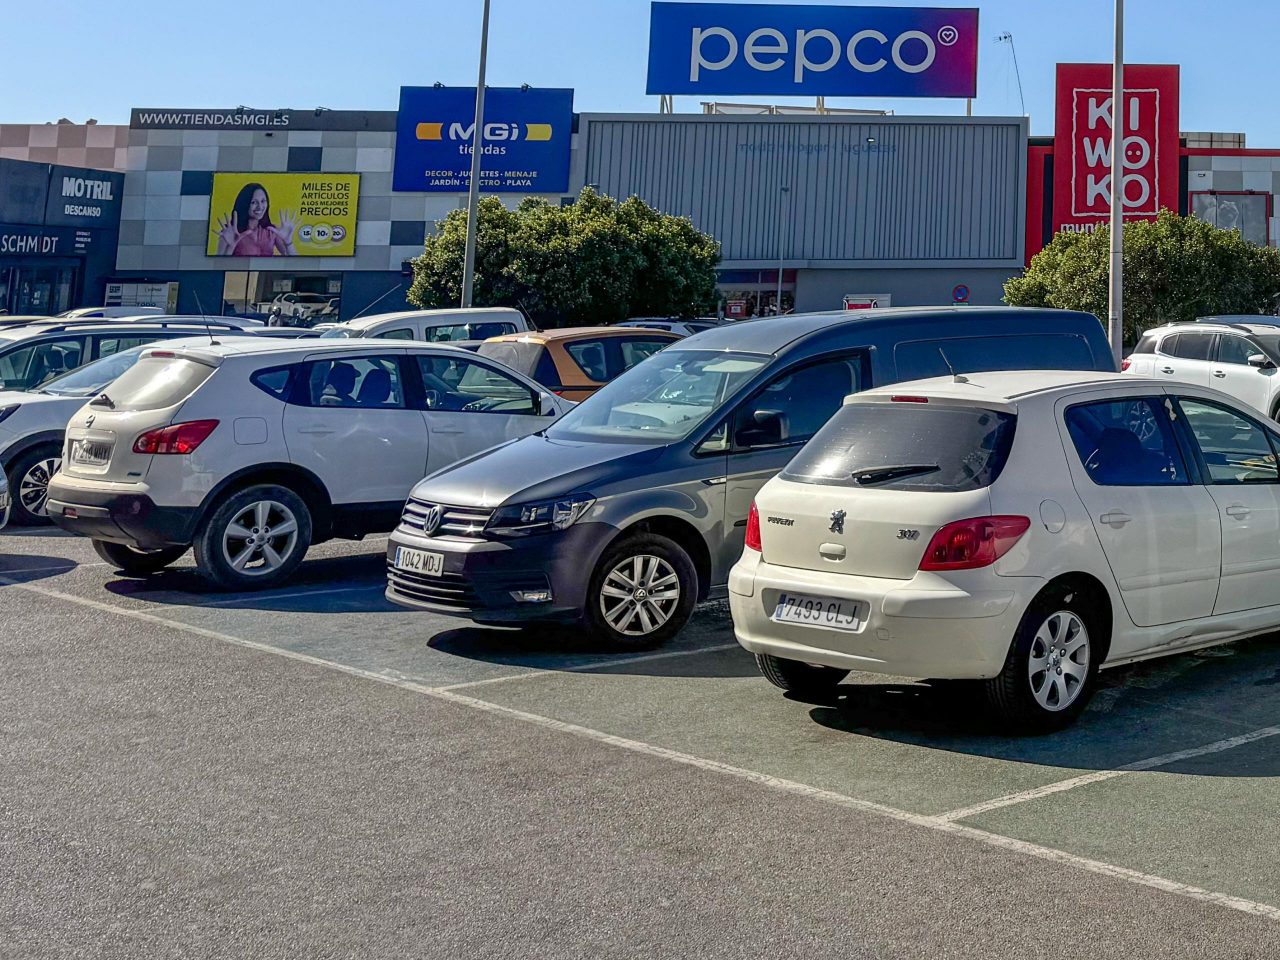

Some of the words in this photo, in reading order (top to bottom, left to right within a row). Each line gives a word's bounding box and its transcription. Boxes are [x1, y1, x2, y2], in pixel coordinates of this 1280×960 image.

[690, 25, 937, 83] pepco
[139, 113, 289, 126] WWW.TIENDASMGI.ES
[62, 176, 113, 200] MOTRIL
[302, 182, 333, 191] MILES
[336, 183, 350, 192] DE
[430, 177, 460, 186] JARDÍN
[64, 204, 101, 217] DESCANSO
[300, 207, 348, 216] PRECIOS
[1, 235, 59, 253] SCHMIDT
[896, 528, 920, 541] 307
[401, 550, 421, 570] 1042
[422, 554, 441, 573] MDJ
[785, 597, 823, 620] 7493
[826, 603, 857, 625] CLJ
